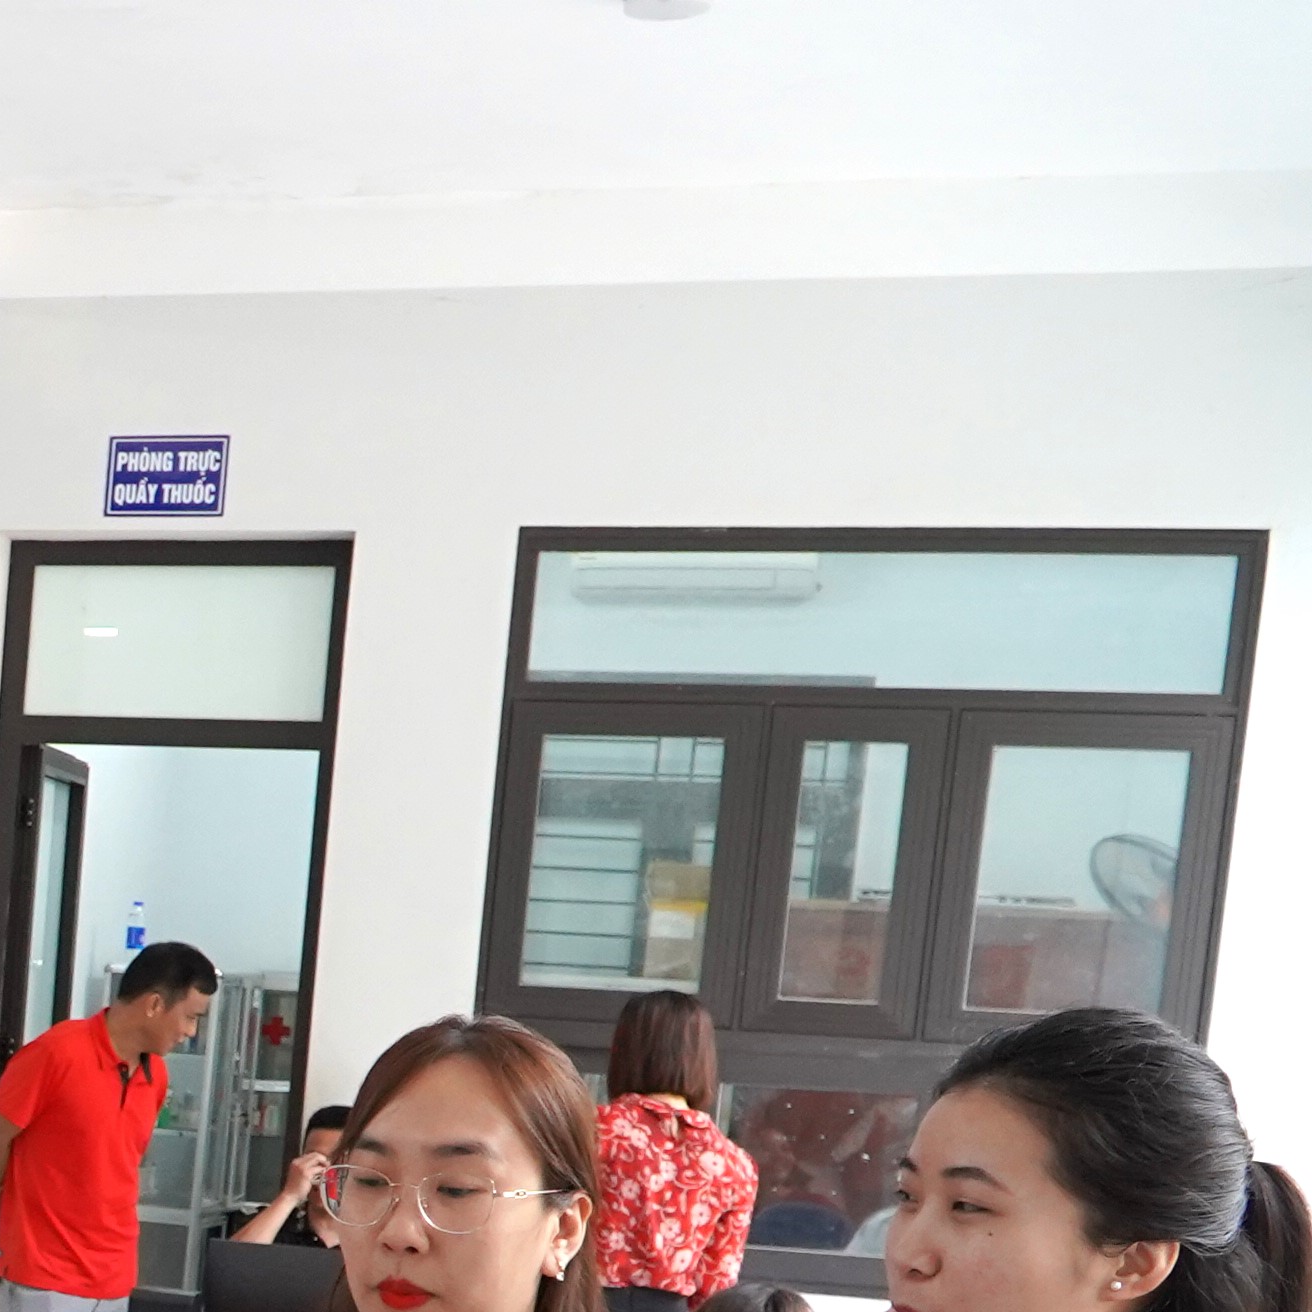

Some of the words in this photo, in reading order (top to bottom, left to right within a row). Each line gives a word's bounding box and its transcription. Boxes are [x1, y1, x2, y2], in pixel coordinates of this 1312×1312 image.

[116, 447, 174, 472] PHÒNG
[178, 449, 221, 476] TRỰC
[114, 477, 158, 506] QUẦY
[162, 477, 216, 504] THUỐC
